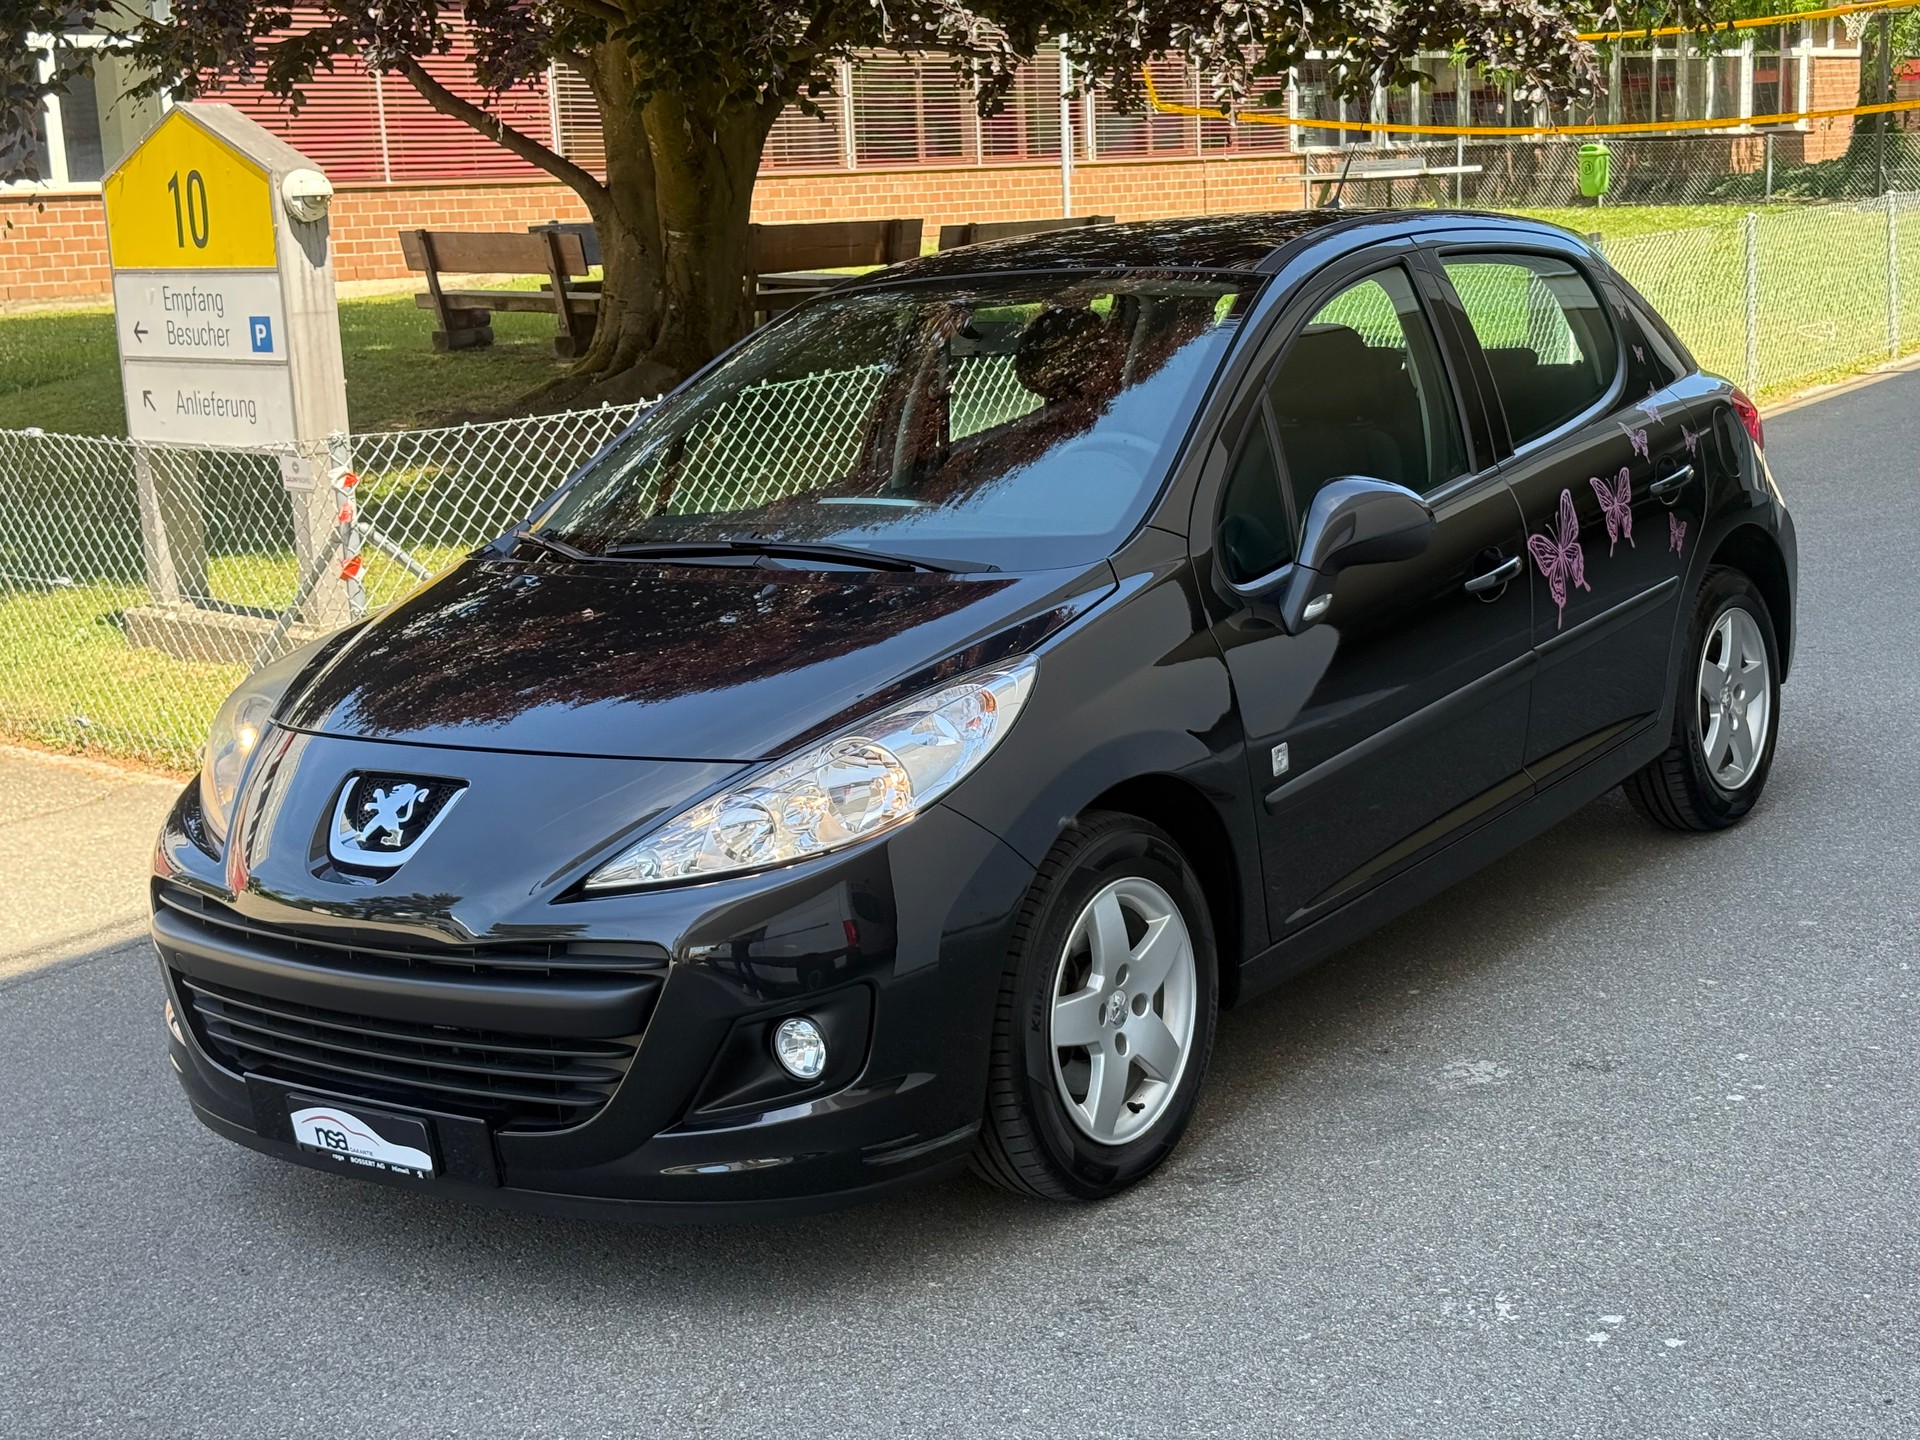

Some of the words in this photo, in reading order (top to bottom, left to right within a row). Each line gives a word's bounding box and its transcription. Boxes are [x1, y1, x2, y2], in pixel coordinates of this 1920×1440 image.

[168, 170, 209, 249] 10
[163, 286, 224, 318] Empfang
[167, 320, 230, 347] Besucher
[255, 324, 267, 346] P
[176, 390, 257, 425] Anlieferung
[314, 1126, 349, 1151] nsa
[350, 1147, 373, 1156] GARANTIE
[350, 1156, 375, 1167] BOSSERT
[376, 1162, 386, 1170] AG
